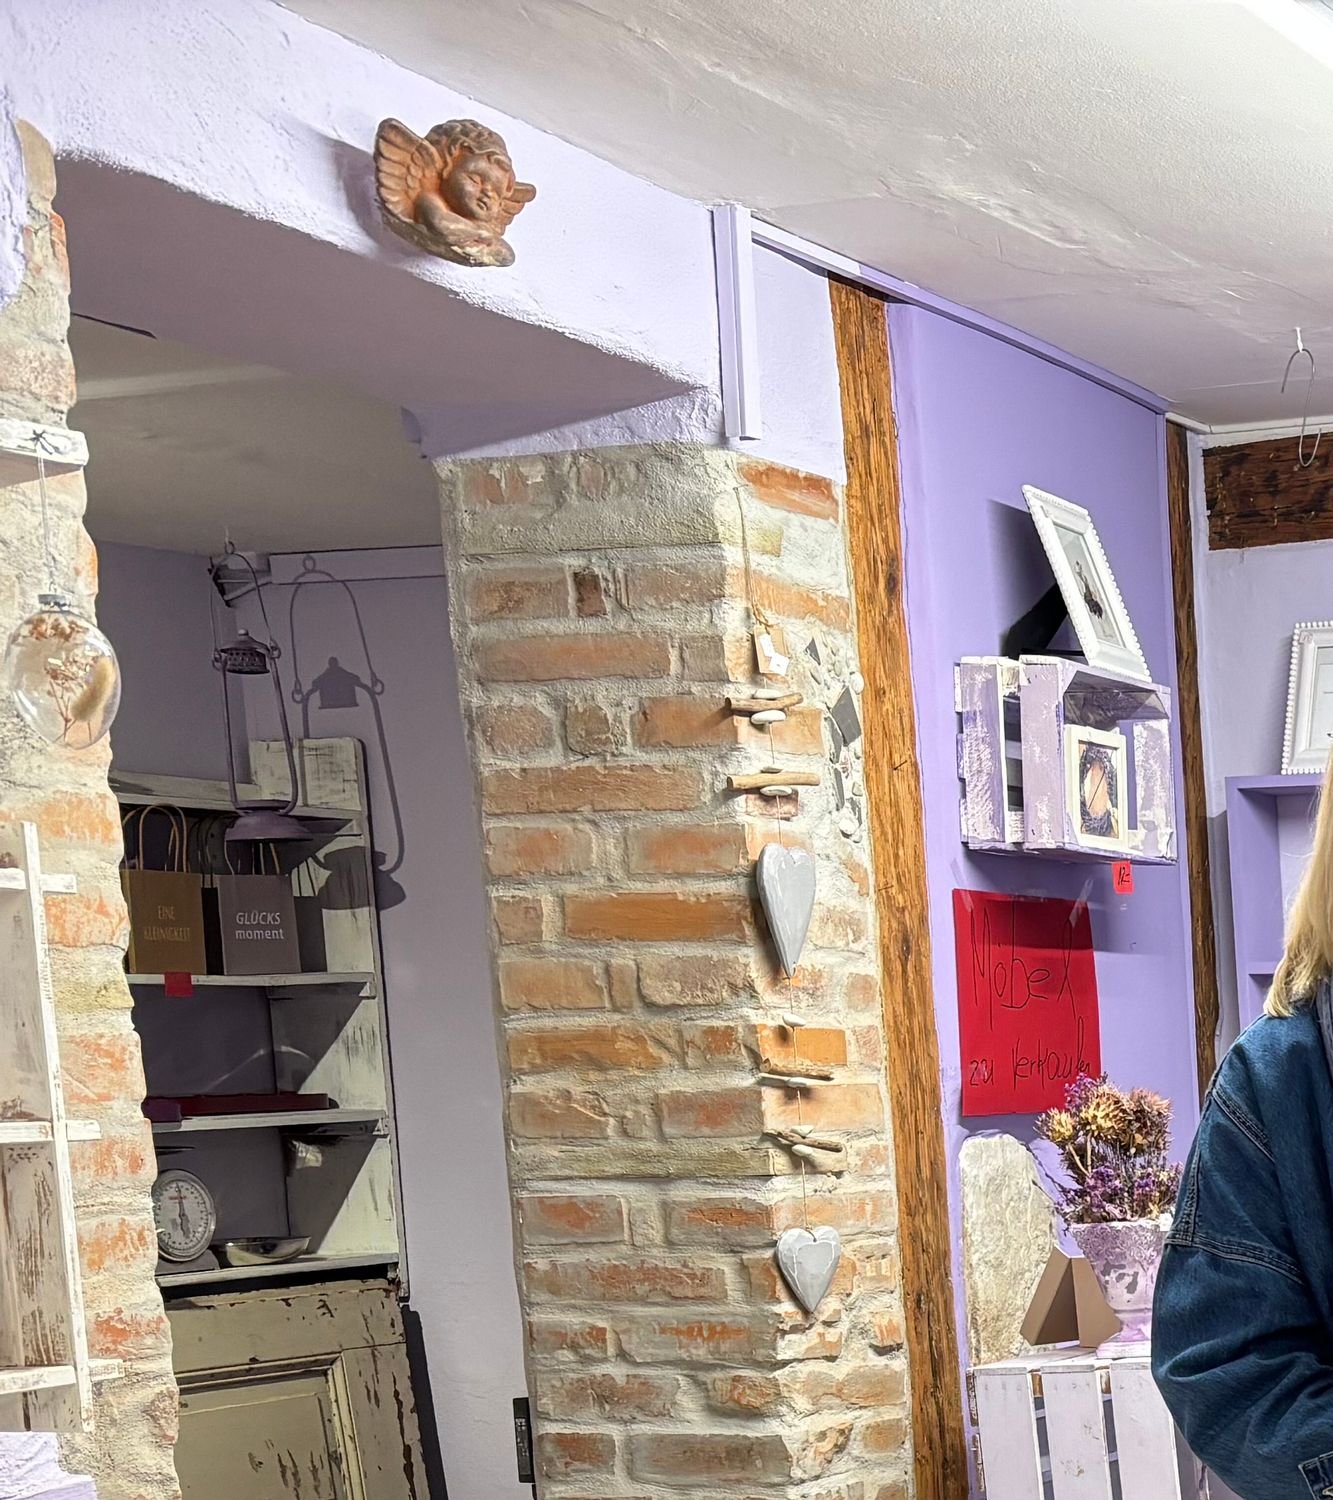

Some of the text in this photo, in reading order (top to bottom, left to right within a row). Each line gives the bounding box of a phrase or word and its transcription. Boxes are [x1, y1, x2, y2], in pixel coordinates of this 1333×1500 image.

[235, 909, 282, 926] GLÜCKS
[234, 927, 285, 941] moment
[970, 900, 1077, 1033] Möbel
